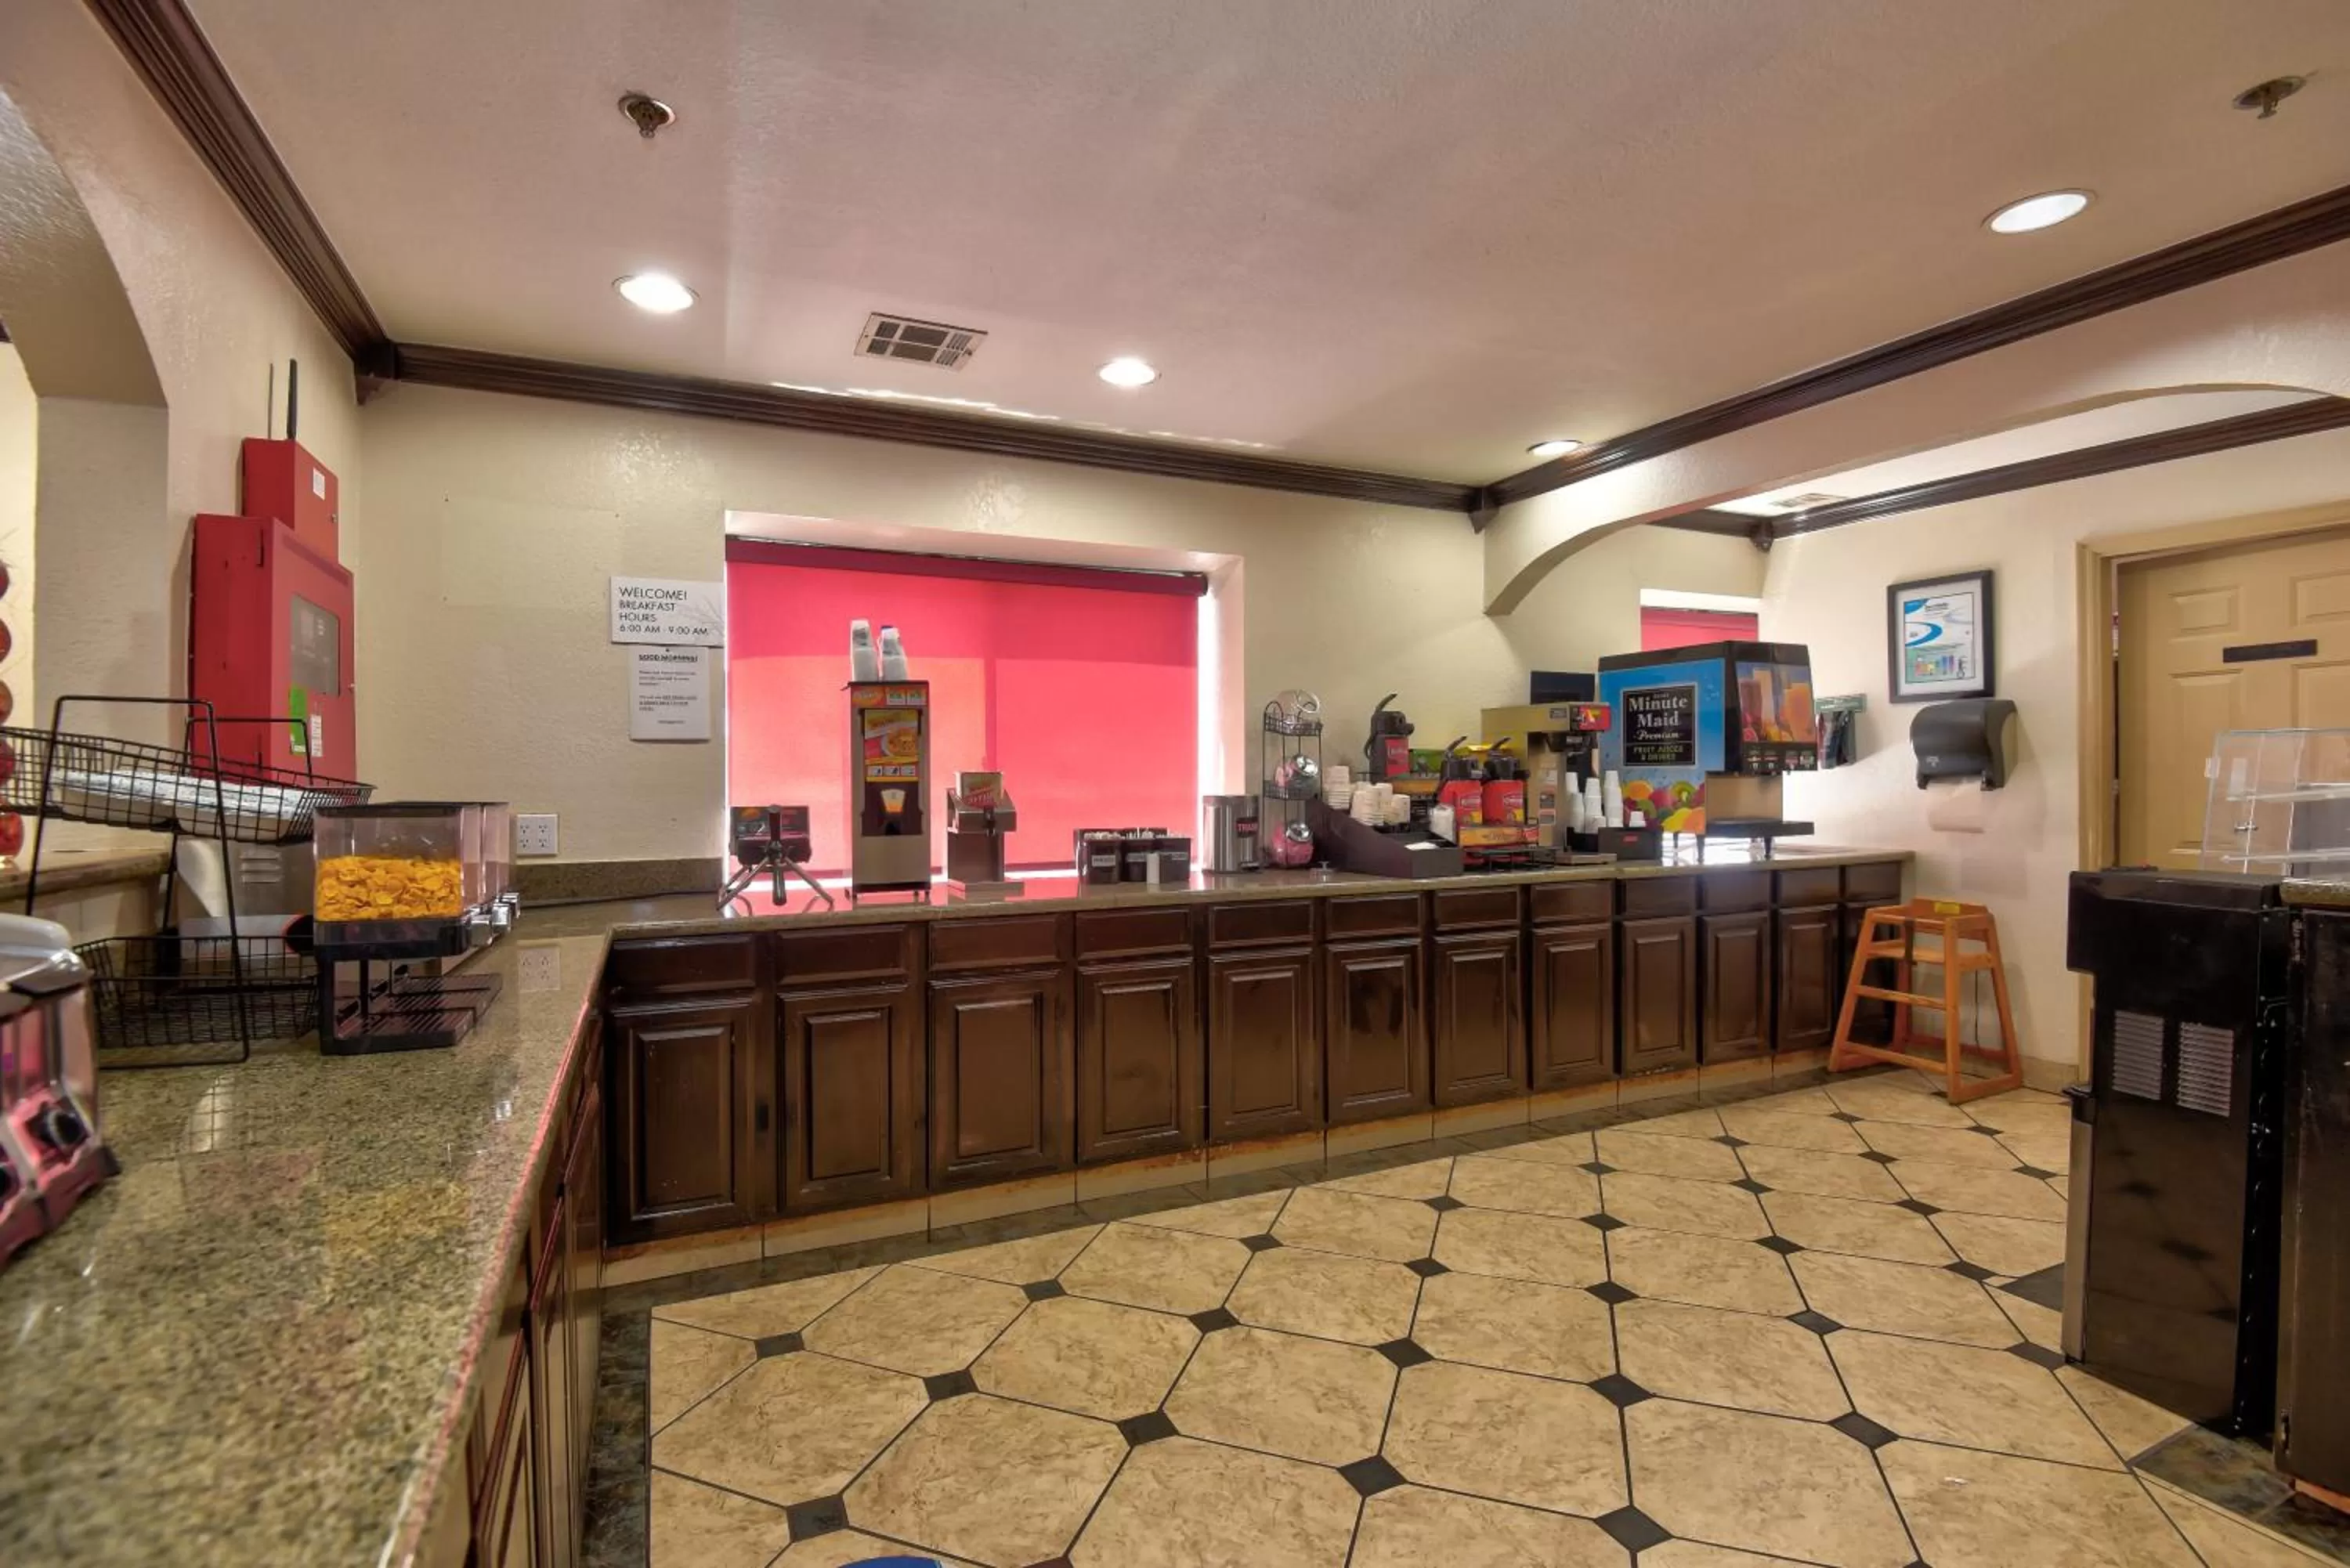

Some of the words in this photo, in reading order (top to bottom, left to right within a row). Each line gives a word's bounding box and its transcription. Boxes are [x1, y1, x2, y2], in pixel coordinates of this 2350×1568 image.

[619, 587, 687, 601] WELCOME!
[619, 599, 676, 612] BREAKFAST
[619, 612, 657, 623] HOURS
[620, 624, 642, 634] 6:00
[645, 625, 660, 634] AM
[692, 627, 708, 636] AM
[1629, 695, 1688, 712] Minute
[1636, 710, 1680, 728] Maid
